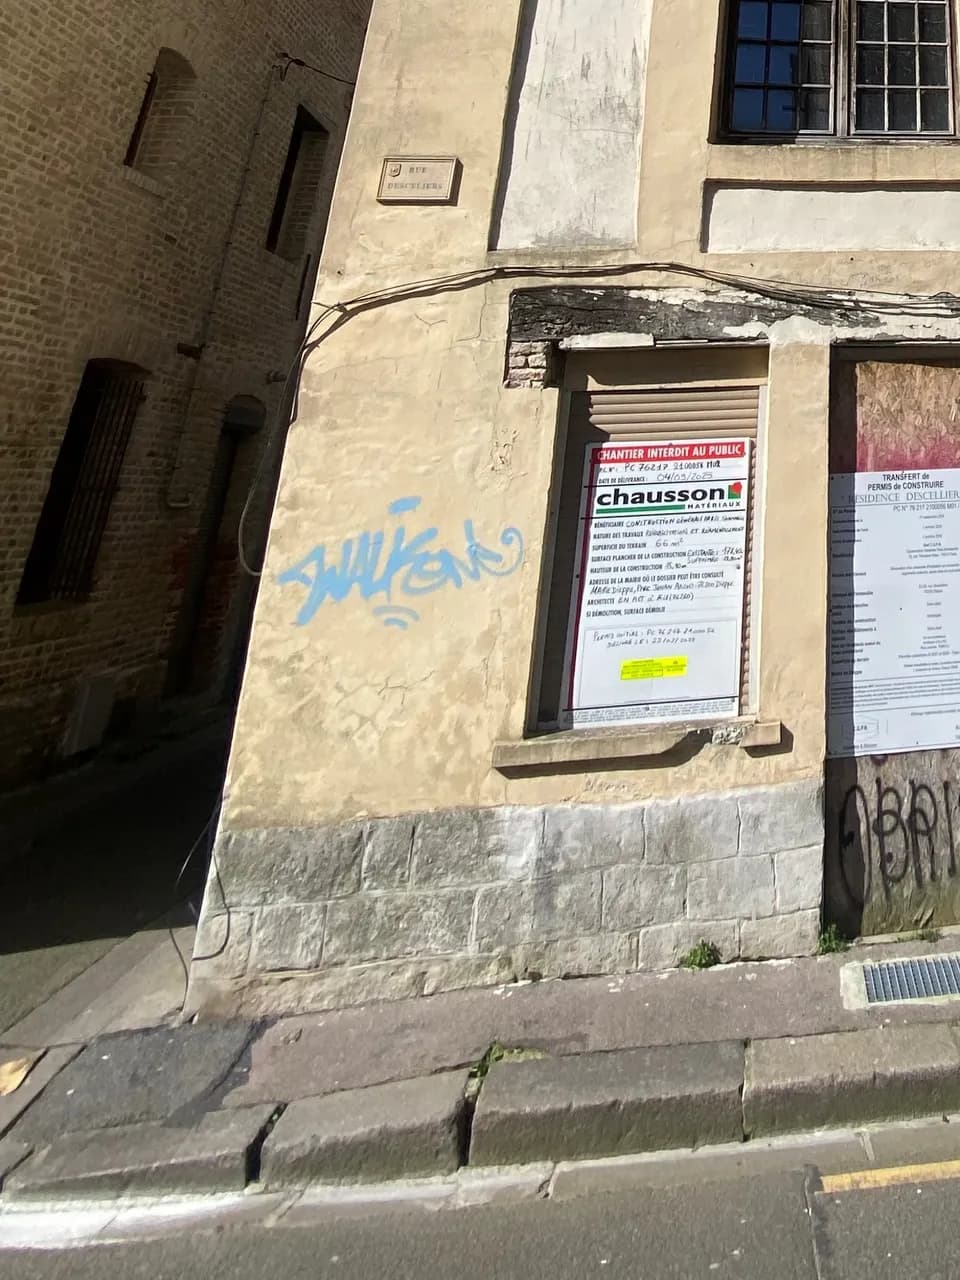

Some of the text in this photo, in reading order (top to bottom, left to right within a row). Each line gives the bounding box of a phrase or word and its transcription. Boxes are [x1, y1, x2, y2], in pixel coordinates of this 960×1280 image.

[598, 444, 742, 460] CHANTIER INTERDIT AU PUBLIC
[882, 473, 921, 481] TRANSFERT
[868, 482, 892, 491] PERMIS
[903, 481, 943, 489] CONSTRUIRE
[597, 487, 725, 505] chausson
